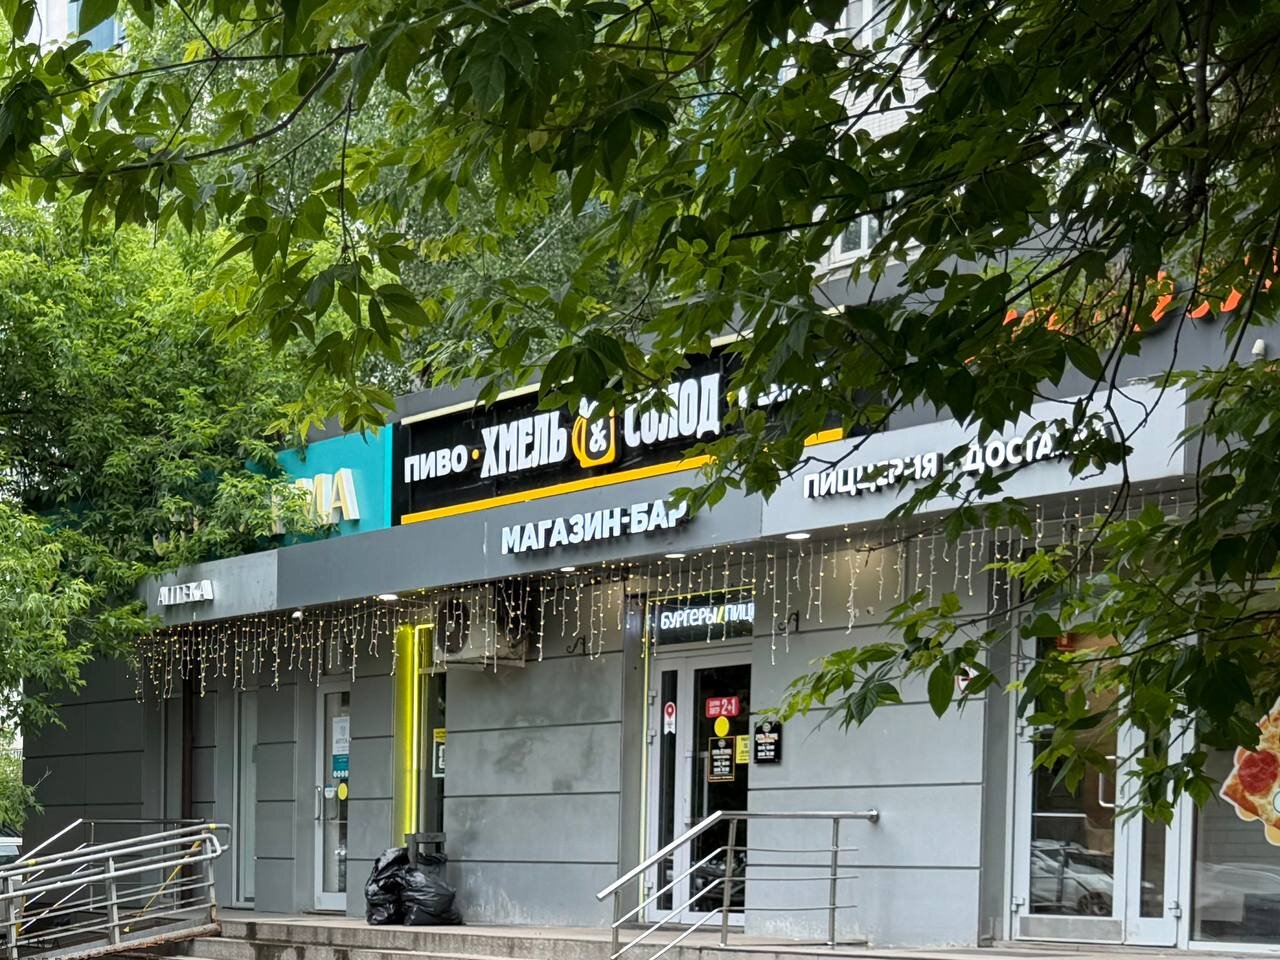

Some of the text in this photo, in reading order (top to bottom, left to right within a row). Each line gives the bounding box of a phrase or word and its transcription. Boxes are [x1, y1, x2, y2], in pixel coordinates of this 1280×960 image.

[404, 444, 468, 483] ПИВО
[480, 410, 568, 478] ХМЕЛЬ
[624, 373, 720, 447] СОЛОД
[962, 418, 1110, 474] ДОСТА
[502, 498, 688, 555] МАГАЗИН-БАР
